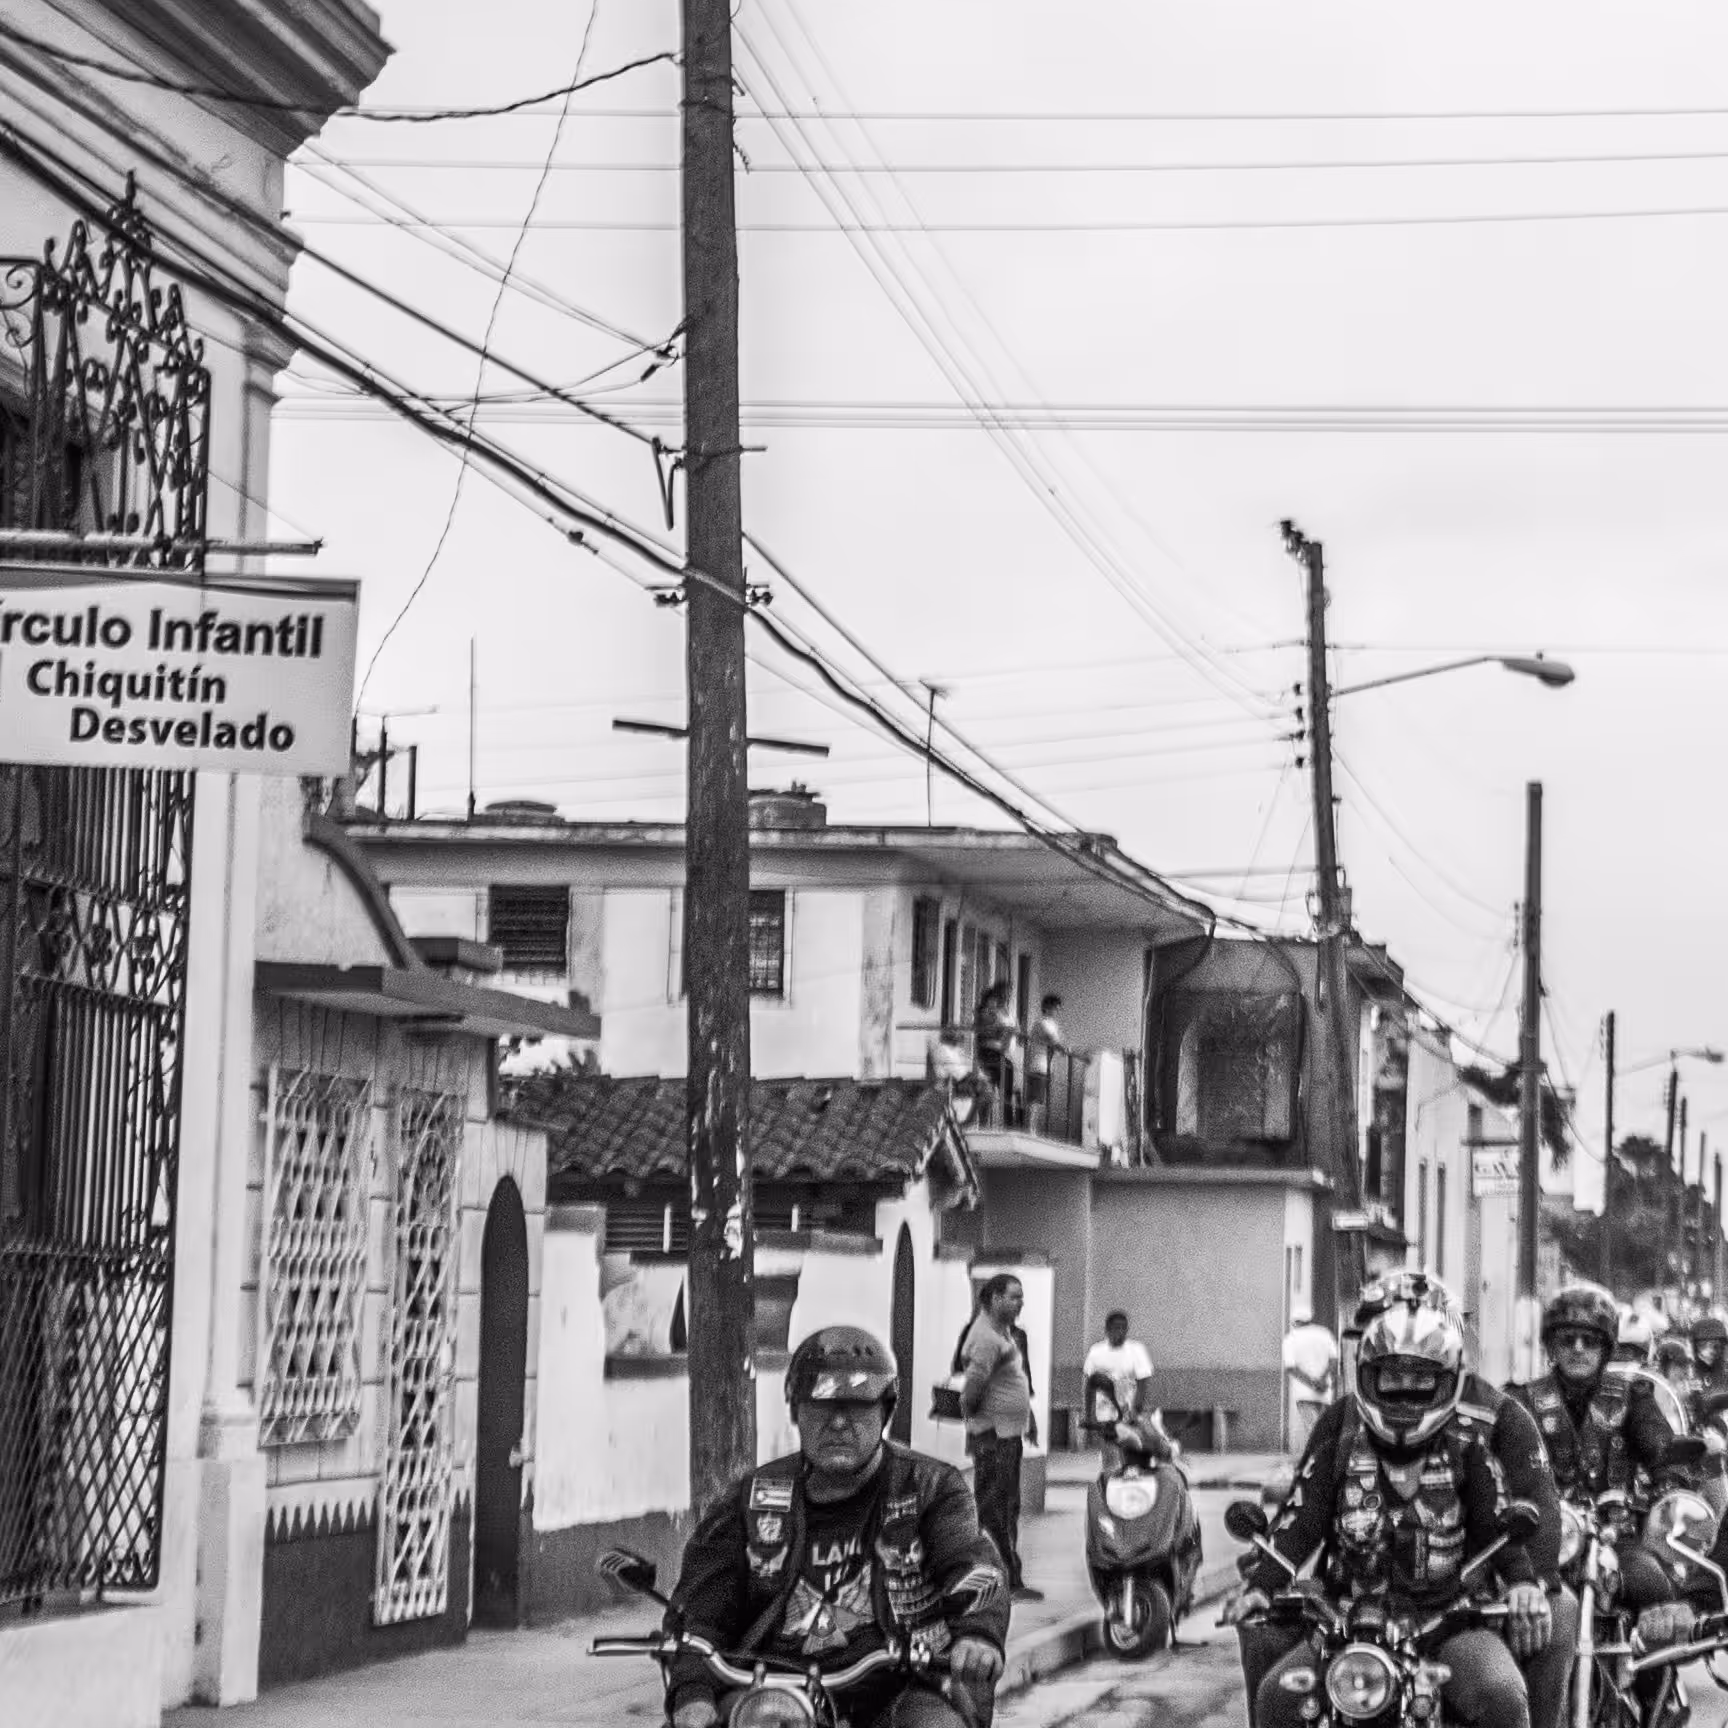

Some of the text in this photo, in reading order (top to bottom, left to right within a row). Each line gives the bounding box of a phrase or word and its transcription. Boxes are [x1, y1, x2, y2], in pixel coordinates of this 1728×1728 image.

[0, 599, 325, 659] rculo Infantil
[26, 659, 227, 709] Chiquitín
[69, 706, 296, 753] Desvelado
